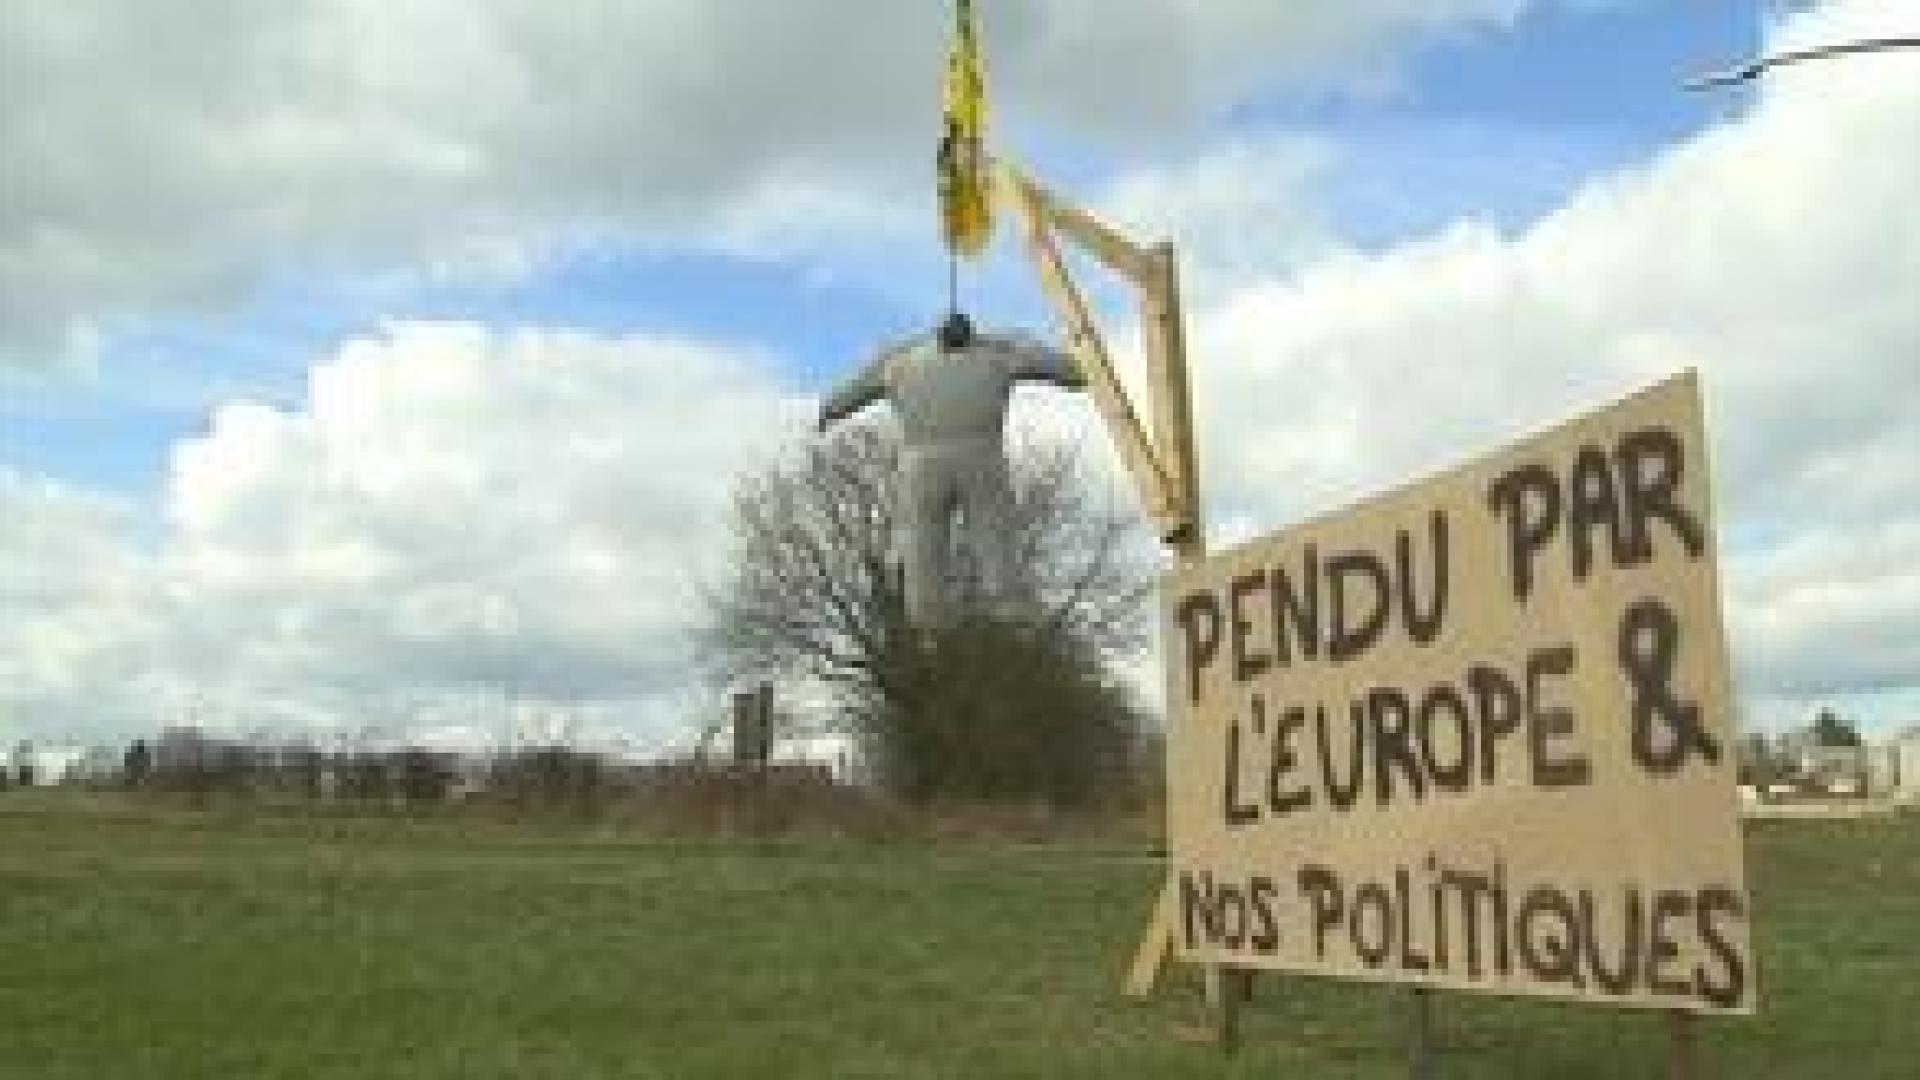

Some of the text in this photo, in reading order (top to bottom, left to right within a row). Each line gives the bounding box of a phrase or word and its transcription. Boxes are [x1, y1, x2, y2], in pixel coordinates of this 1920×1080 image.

[1175, 426, 1704, 707] PENDU PAR
[1225, 599, 1722, 826] L'EUROPE &
[1178, 868, 1280, 951] NOS
